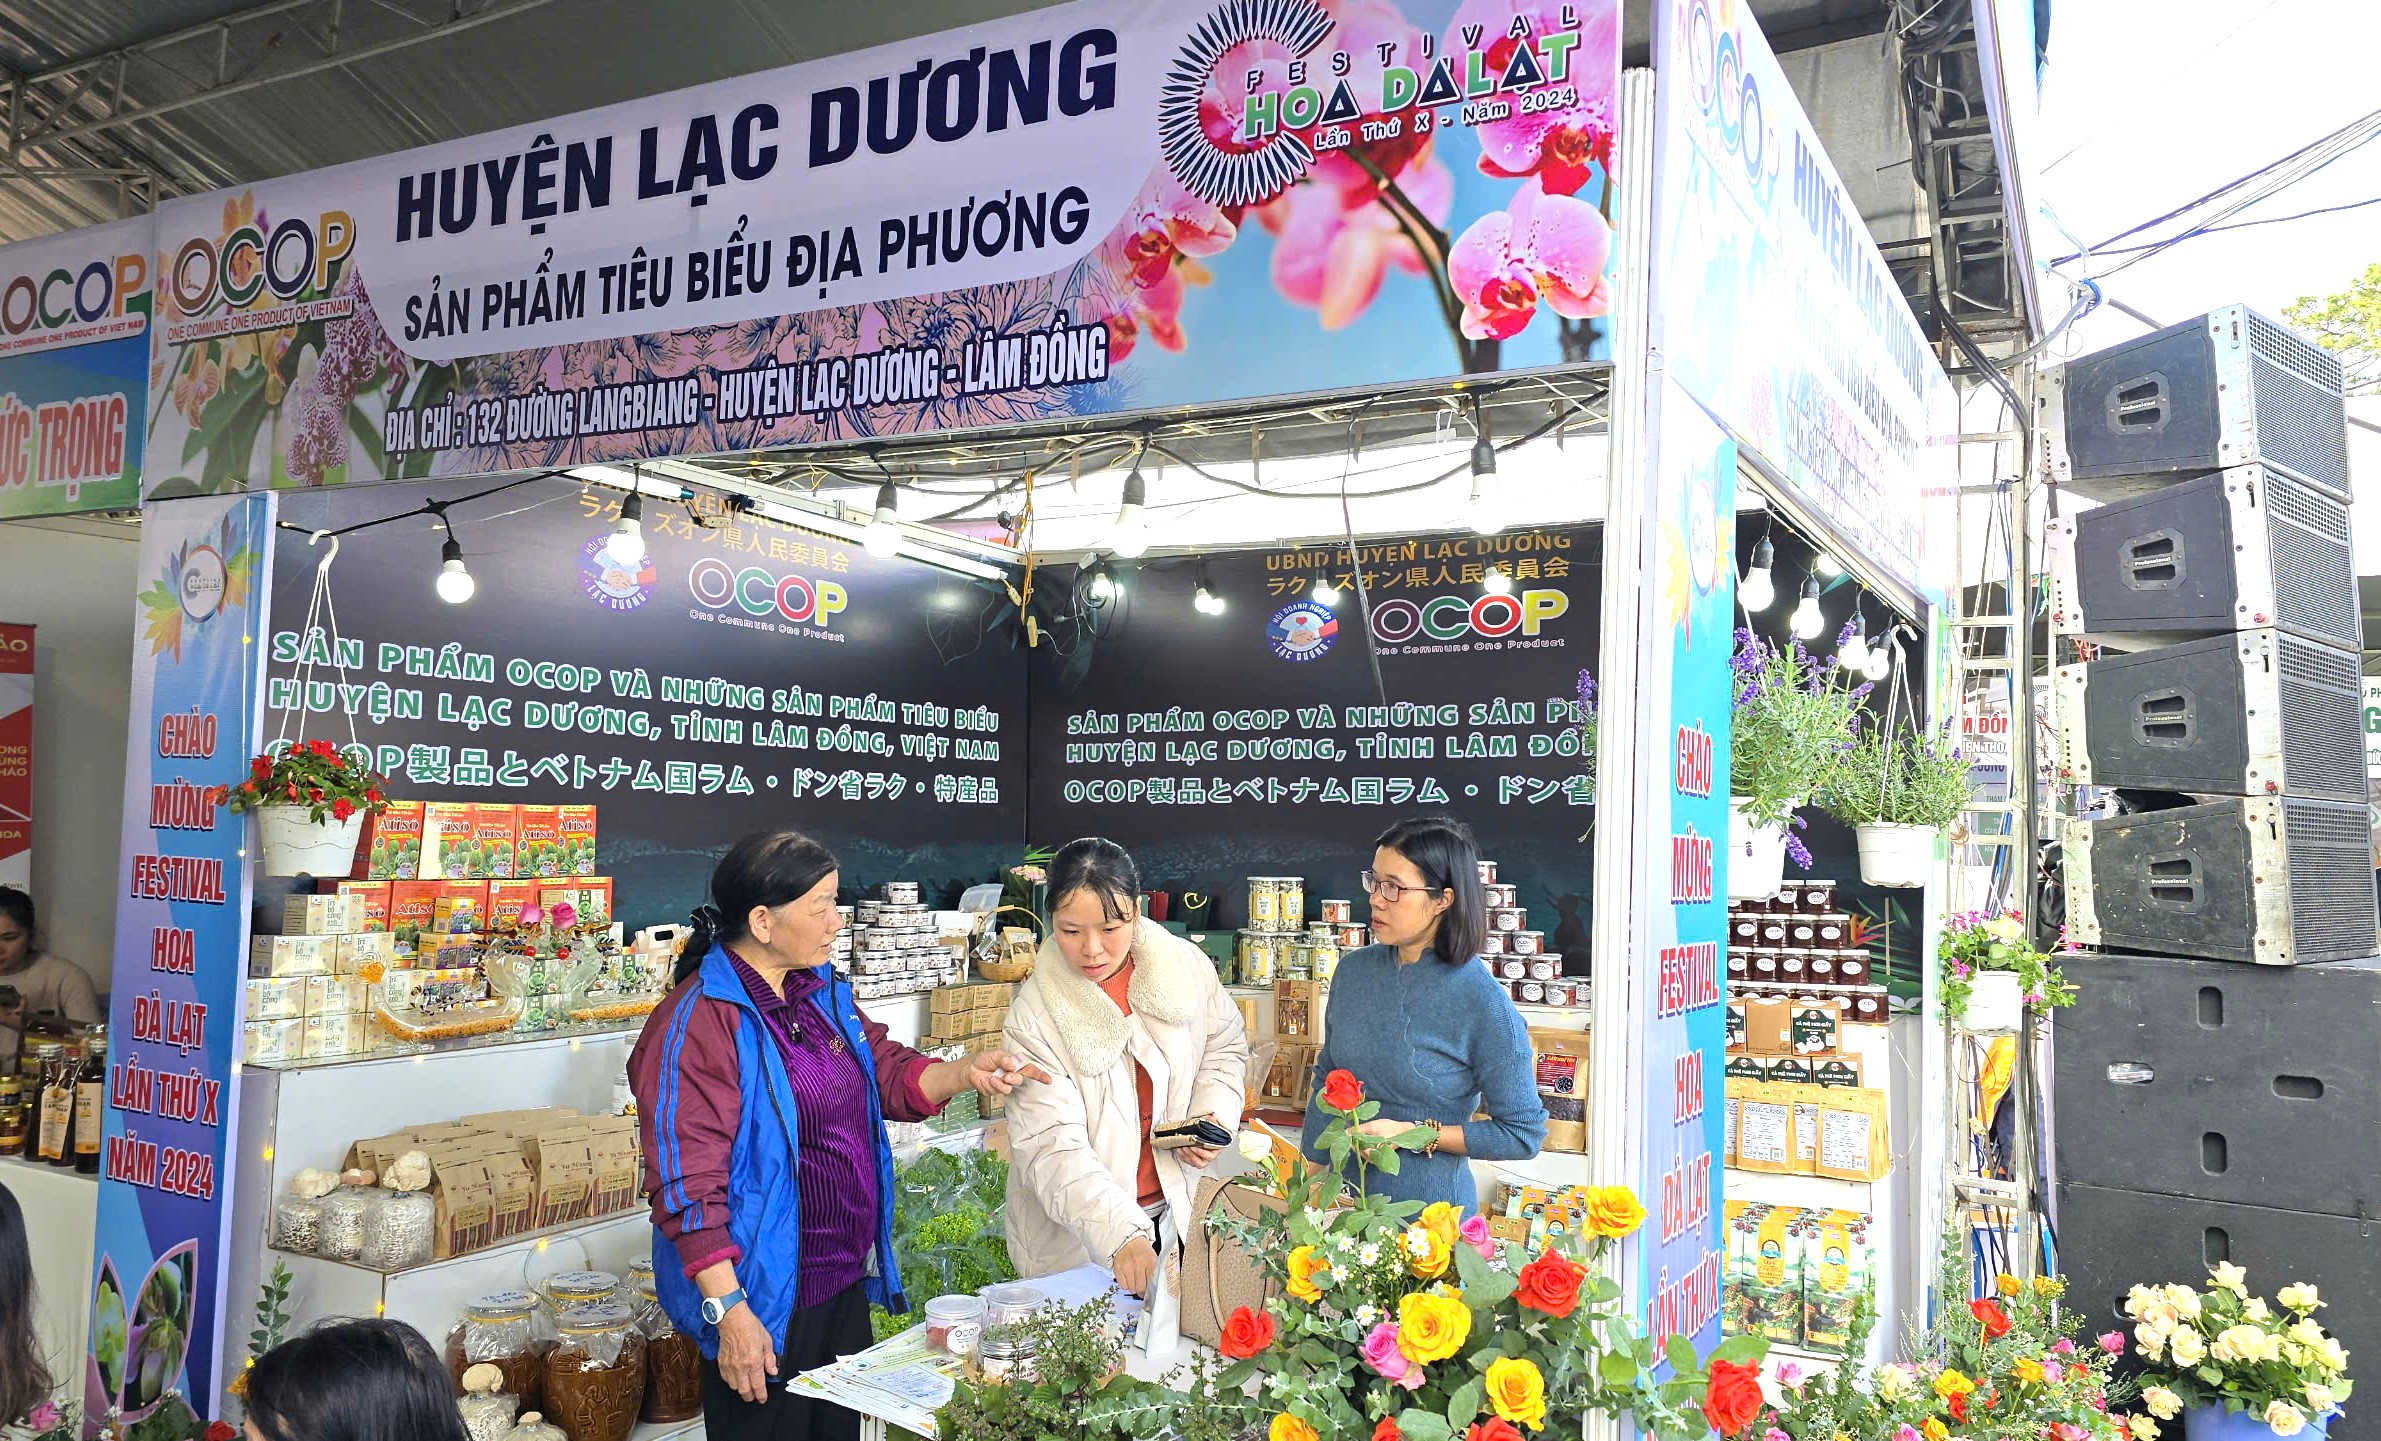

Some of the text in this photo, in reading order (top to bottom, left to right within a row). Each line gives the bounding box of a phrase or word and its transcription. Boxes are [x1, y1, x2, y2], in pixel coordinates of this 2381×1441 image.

[1245, 4, 1581, 92] FESTIVAL
[396, 28, 1118, 243] HUYỆN LẠC DƯƠNG
[1243, 77, 1360, 140] HOA
[1316, 87, 1578, 151] Lần Thứ X Năm 2024
[2, 254, 147, 336] OCOP
[172, 210, 356, 317] OCOP
[404, 186, 1091, 343] SẢN PHẨM TIÊU BIỂU ĐỊA PHƯƠNG
[1793, 127, 1924, 404] HUYỆN LẠC DƯƠNG
[65, 328, 97, 340] PRODUCT
[99, 326, 107, 335] OF
[168, 299, 351, 342] ONE COMMUNE ONE PRODUCT OF VIETNAM
[385, 312, 1109, 463] ĐỊA CHỈ 132 ĐƯỜNG LANGBIANG HUYỆN LẠC DƯƠNG LÂM ĐỒNG
[38, 397, 125, 497] TRỌNG
[1266, 550, 1329, 572] UBND
[1423, 540, 1468, 564] LẠC
[688, 557, 848, 628] OCOP
[689, 608, 845, 643] One Commune One Product
[1283, 602, 1307, 615] DOANH
[1371, 588, 1570, 643] OCOP
[272, 626, 999, 733] SẢN PHẨM OCOP VÀ NHỮNG SẢN PHẨM TIÊU BIỂU
[1402, 642, 1470, 655] Commune
[1474, 640, 1502, 651] One
[1507, 637, 1565, 650] Product
[158, 705, 217, 758] CHÀO
[269, 677, 999, 763] HUYỆN LẠC DƯƠNG, TỈNH LÂM ĐỒNG, VIỆT NAM
[1066, 739, 1156, 767] HUYỆN
[1165, 739, 1218, 766] LẠC
[1227, 735, 1347, 763] DƯƠNG,
[1356, 733, 1434, 760] TỈNH
[1446, 731, 1518, 758] LÂM
[1067, 706, 1119, 735] SẢN
[1126, 705, 1204, 733] PHẨM
[1213, 709, 1288, 731] OCOP
[1298, 703, 1336, 729] VÀ
[1346, 701, 1459, 729] NHỮNG
[1468, 697, 1535, 726] SẢN
[1675, 718, 1712, 799] CHÀO
[150, 776, 217, 830] MỪNG
[131, 854, 226, 904] FESTIVAL
[1671, 821, 1713, 904] MỪNG
[151, 927, 196, 974] HOA
[1658, 942, 1719, 1019] FESTIVAL
[132, 989, 208, 1057] ĐÀ LẠT
[110, 1052, 221, 1127] LẦN THỨ X
[1673, 1049, 1704, 1126] HOA
[106, 1131, 215, 1200] NĂM 2024
[1661, 1150, 1711, 1246] ĐÀ LẠT
[1647, 1246, 1721, 1372] LẦN THỨ X
